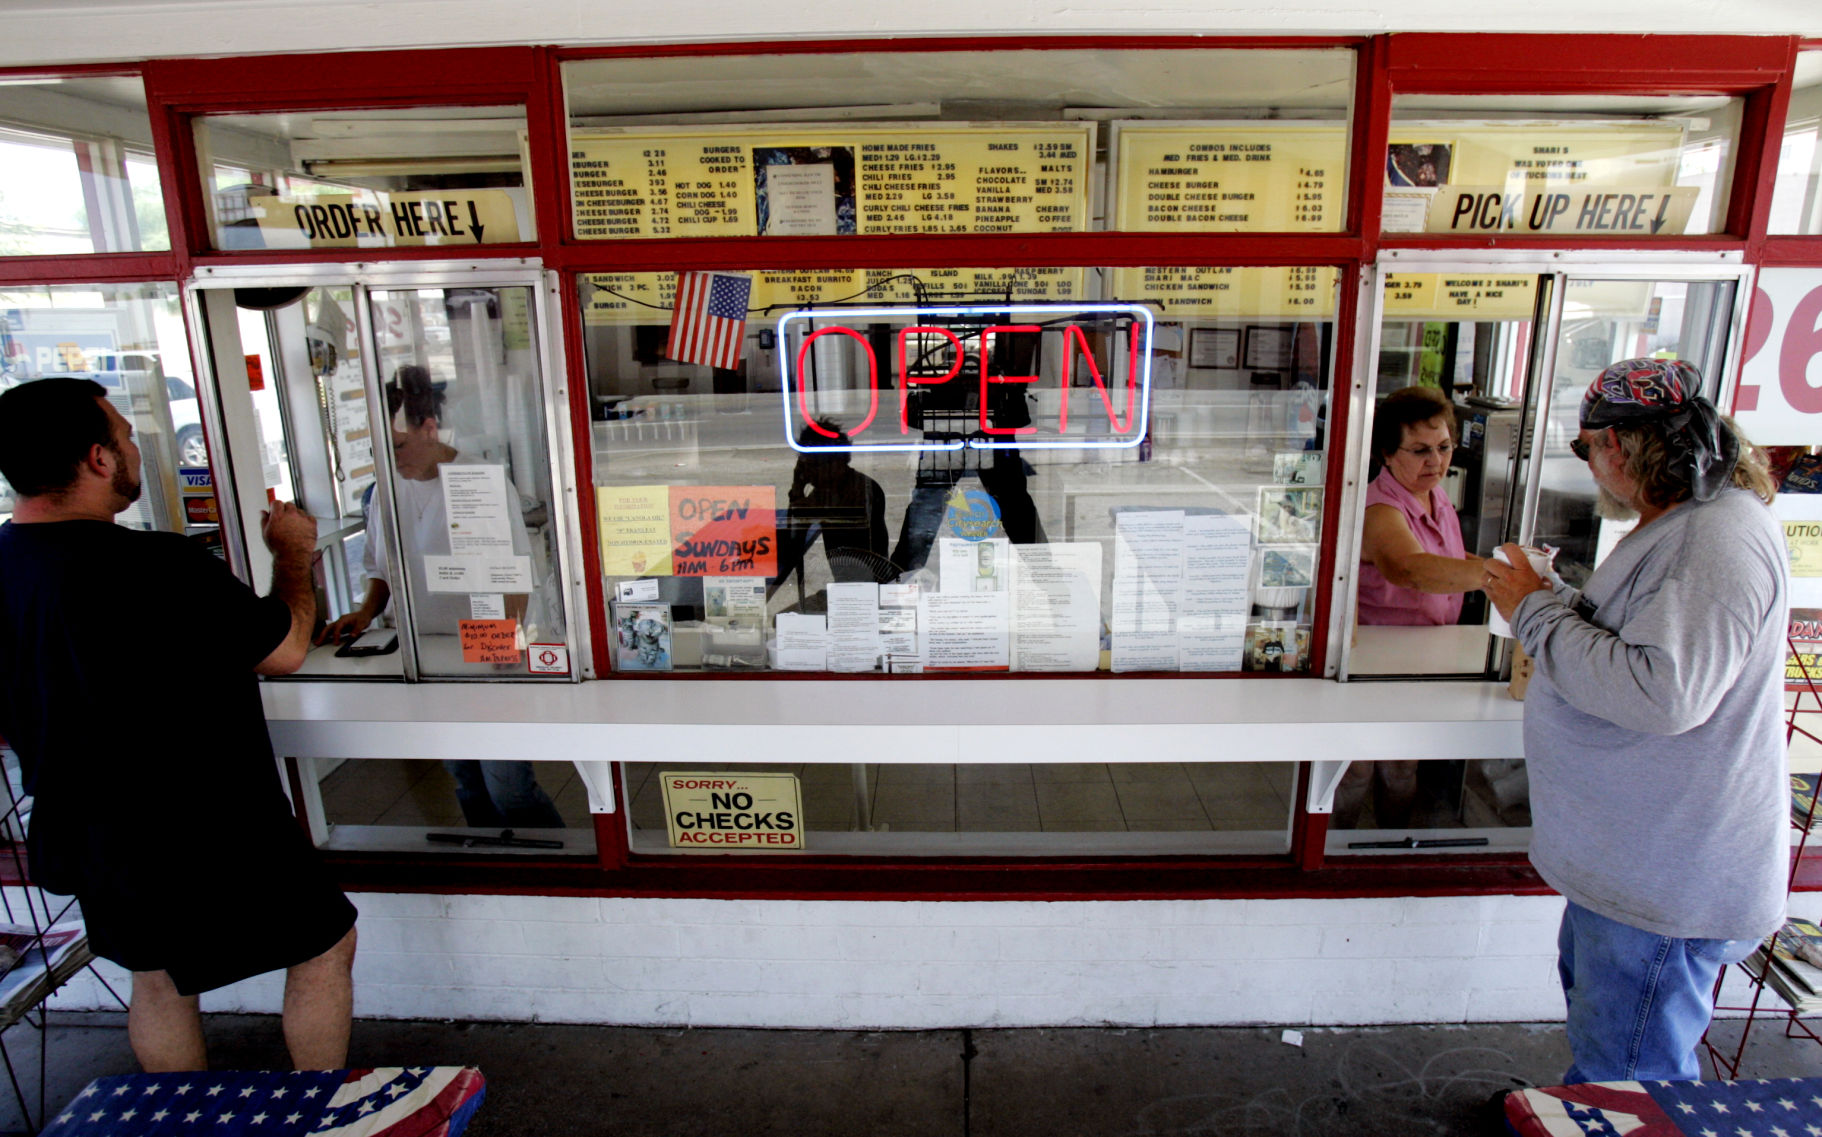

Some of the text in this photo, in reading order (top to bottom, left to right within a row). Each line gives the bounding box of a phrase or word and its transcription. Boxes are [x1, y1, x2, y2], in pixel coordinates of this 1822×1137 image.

[1190, 144, 1225, 152] COMBOS
[699, 156, 731, 164] COOKED
[294, 201, 464, 239] ORDER HERE
[1452, 193, 1523, 230] PICK
[1528, 194, 1570, 230] UP
[1576, 194, 1654, 230] HERE
[797, 322, 1140, 438] OPEN
[678, 498, 750, 521] OPEN
[1786, 525, 1822, 537] UTIO
[675, 531, 770, 560] SUNDAYS
[672, 780, 748, 790] SORRY...
[711, 793, 753, 810] NO
[676, 812, 794, 830] CHECKS
[679, 832, 795, 844] ACCEPTED
